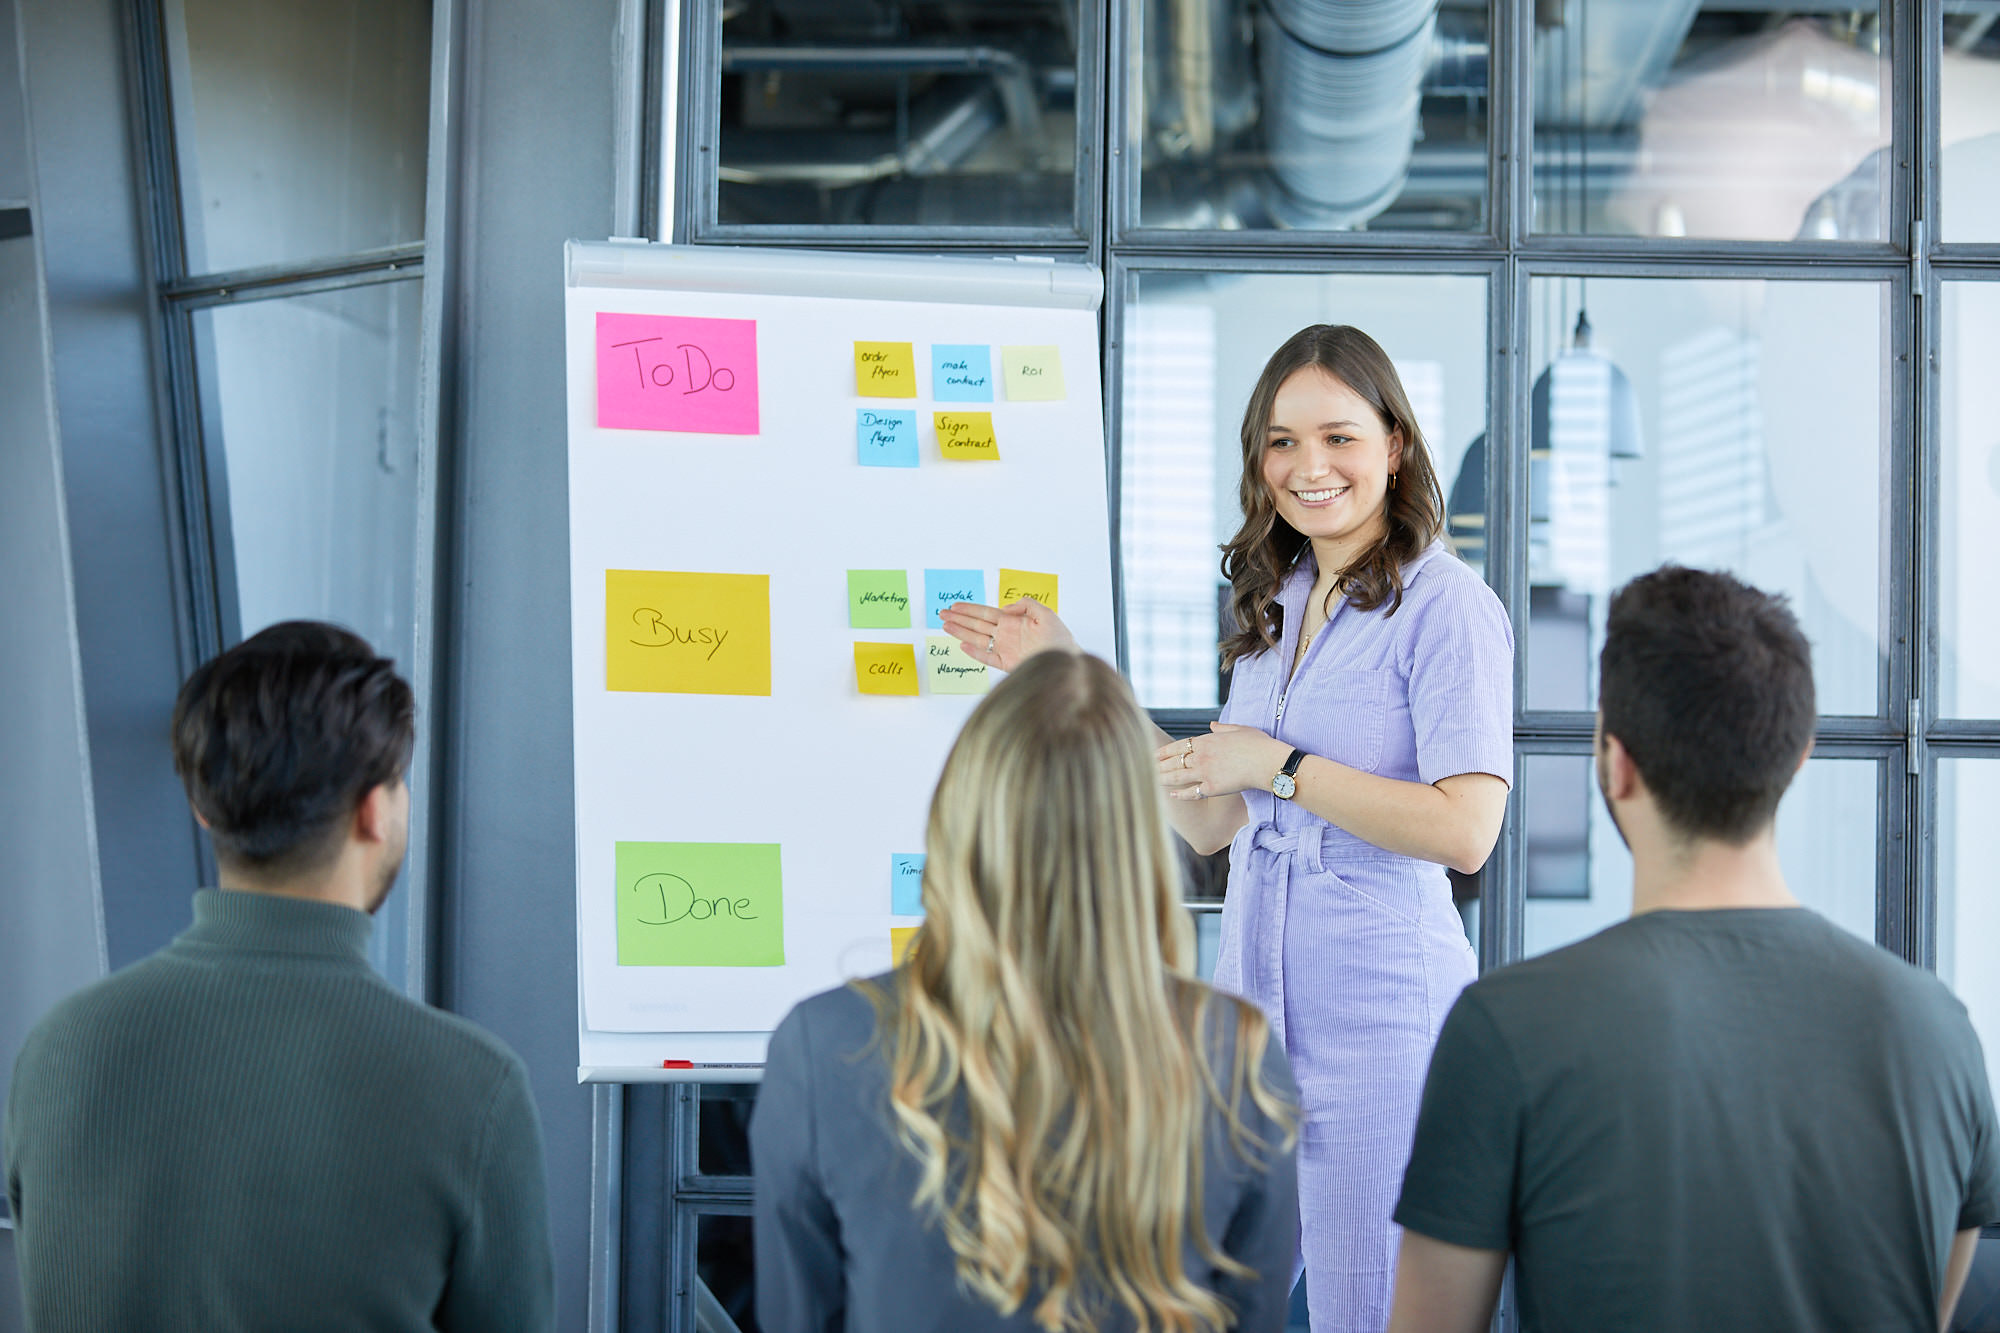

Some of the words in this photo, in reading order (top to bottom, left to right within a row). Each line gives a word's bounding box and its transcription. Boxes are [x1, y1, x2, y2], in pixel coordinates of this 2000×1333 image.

[1022, 365, 1042, 376] ROI
[861, 413, 902, 430] Design
[937, 416, 969, 436] Sign
[947, 437, 992, 448] contract
[859, 591, 908, 610] Marketing
[630, 608, 728, 661] Busy
[930, 645, 950, 656] Risk
[634, 873, 759, 925] Done
